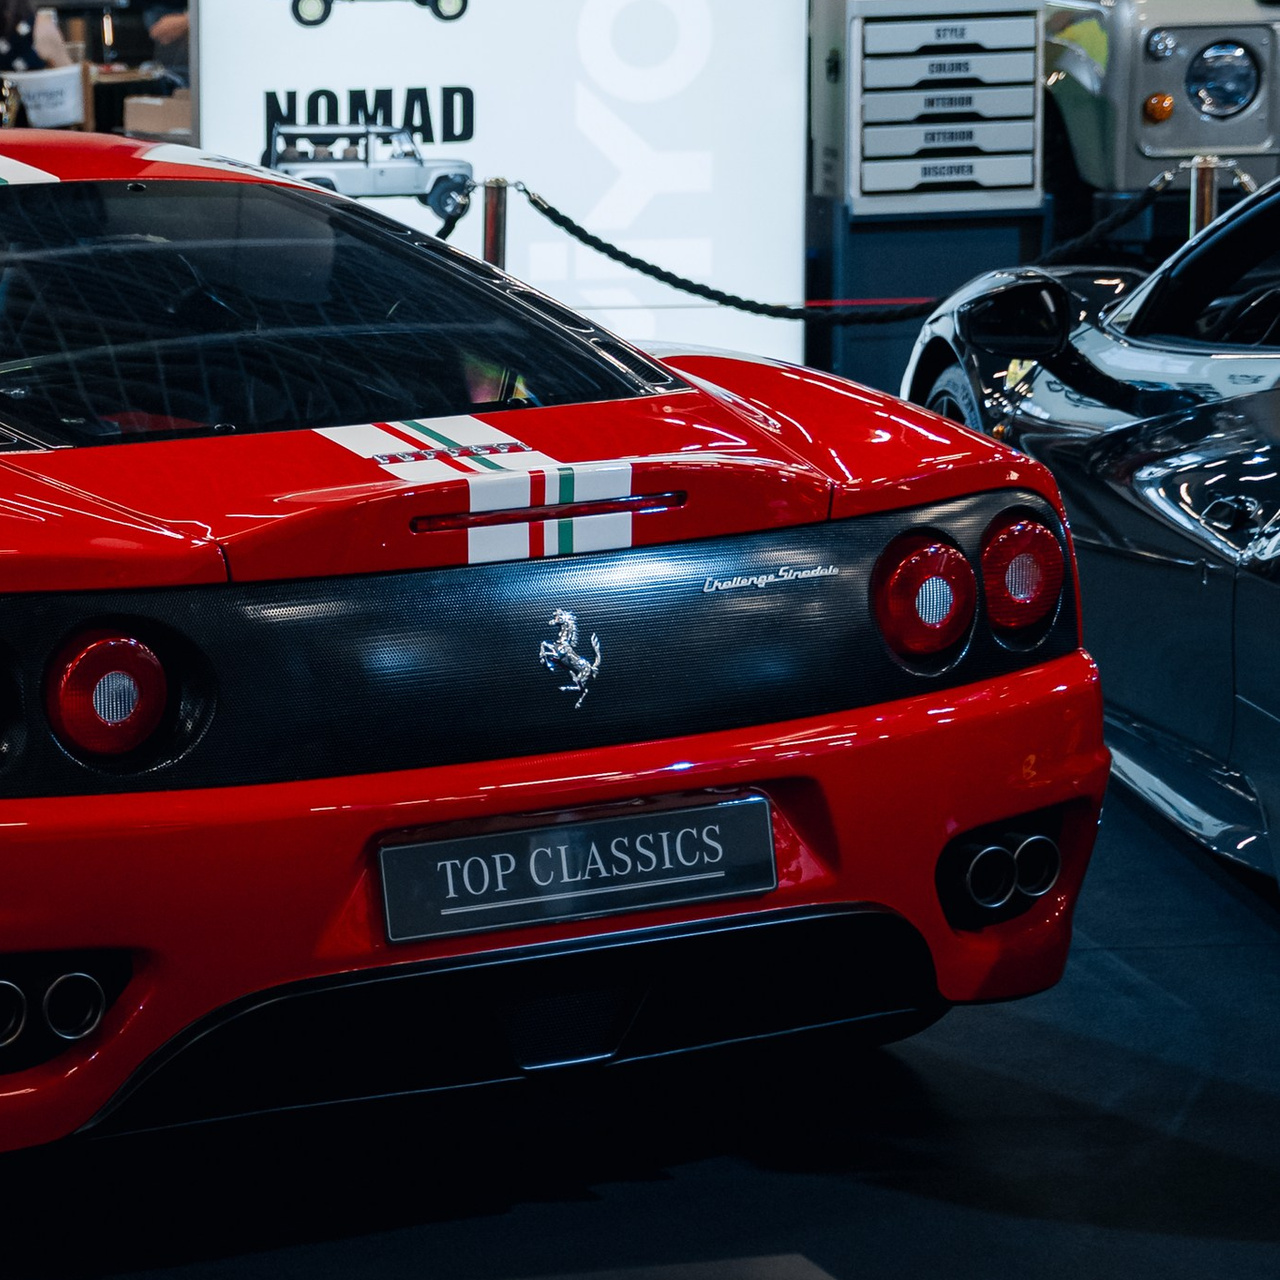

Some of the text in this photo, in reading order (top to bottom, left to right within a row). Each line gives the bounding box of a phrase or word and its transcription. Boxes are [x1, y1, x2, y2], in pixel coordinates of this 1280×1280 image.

[935, 26, 967, 40] STYLE
[928, 62, 971, 75] COLORS
[924, 96, 972, 109] INTERIOR
[266, 86, 474, 145] NOMAD
[924, 130, 973, 144] EXTERIOR
[921, 164, 973, 178] DISCOVER
[703, 573, 775, 594] Challenge
[437, 825, 724, 899] TOP CLASSICS
